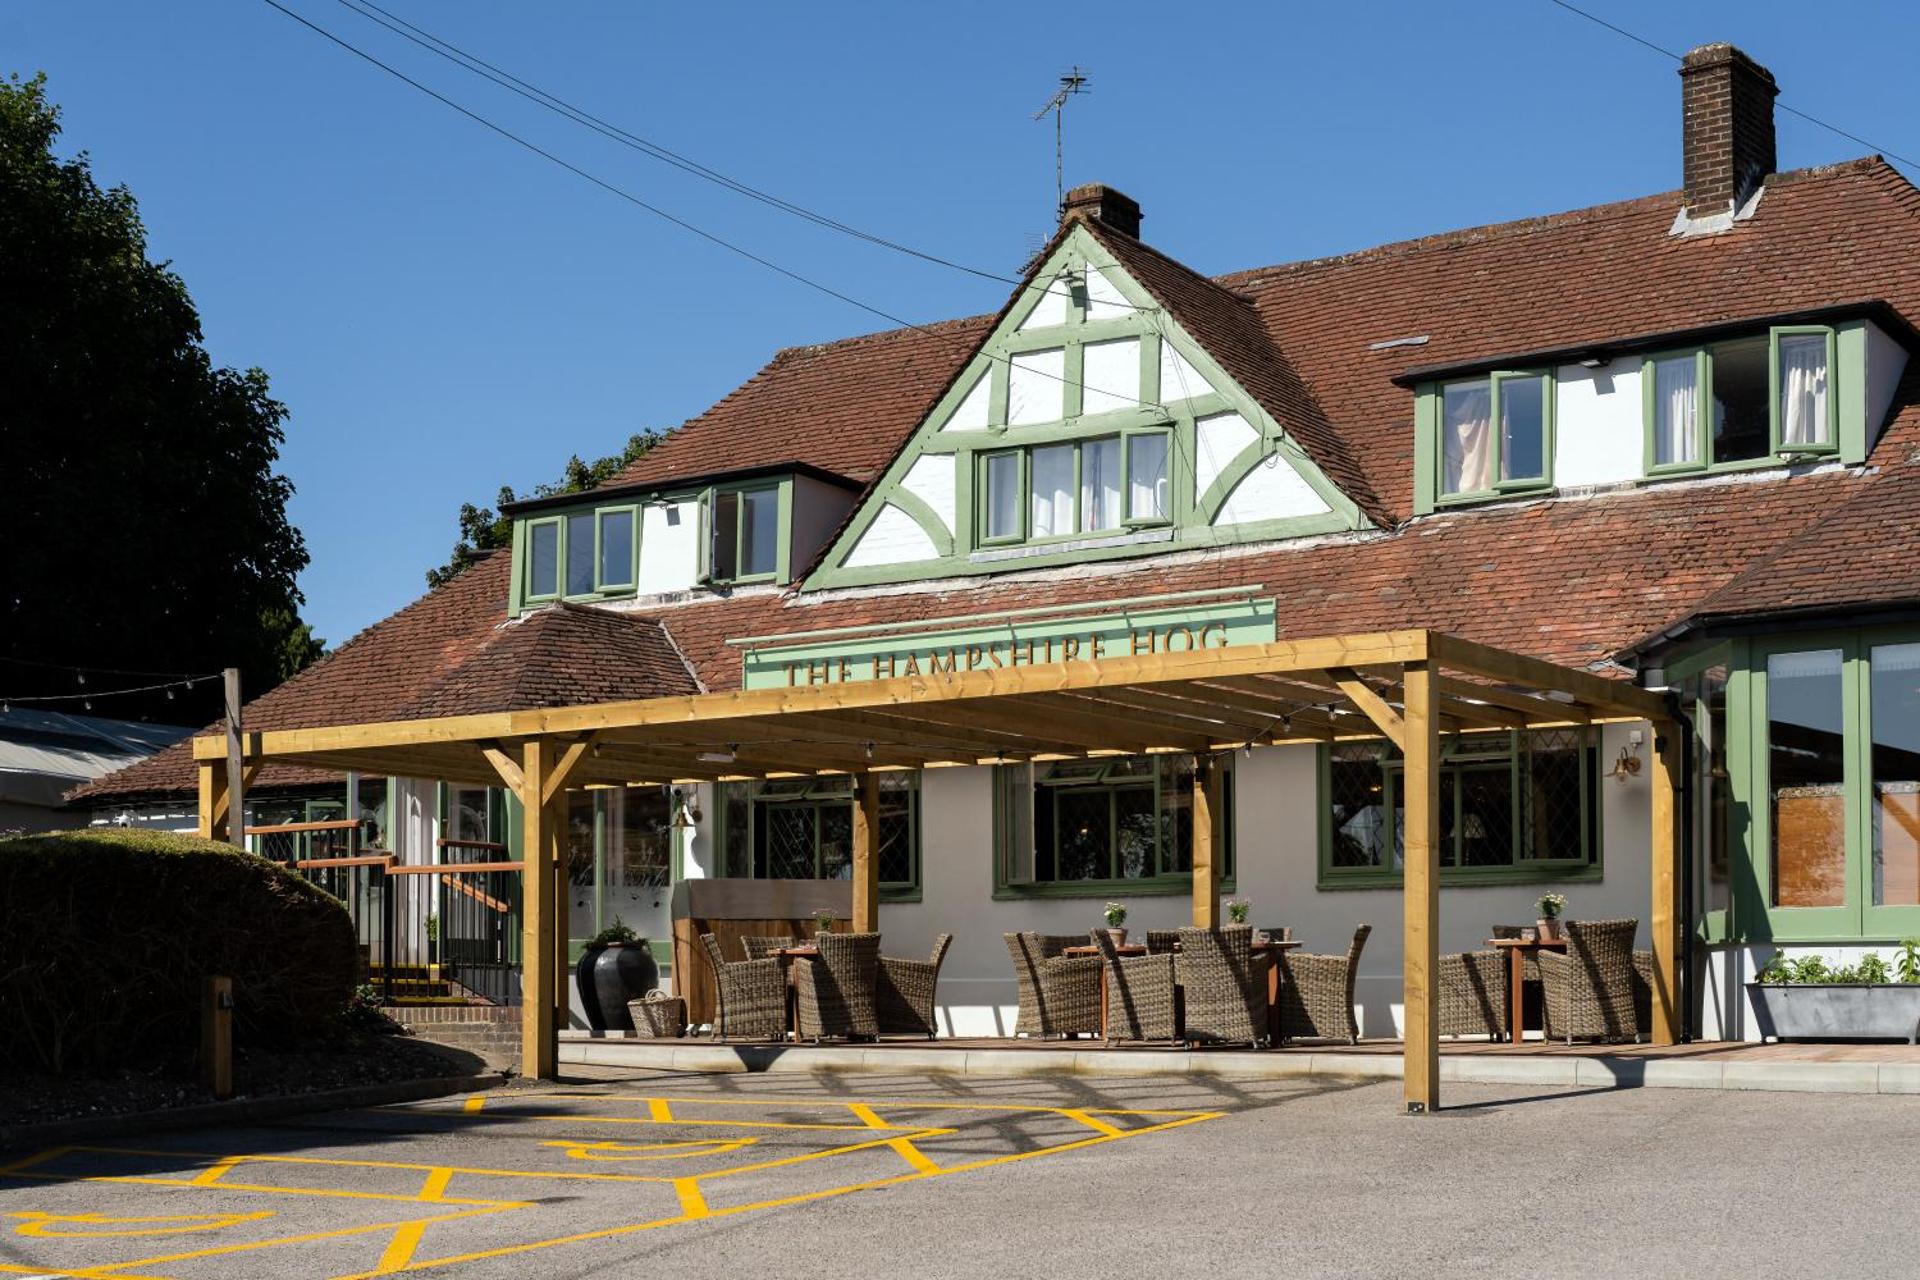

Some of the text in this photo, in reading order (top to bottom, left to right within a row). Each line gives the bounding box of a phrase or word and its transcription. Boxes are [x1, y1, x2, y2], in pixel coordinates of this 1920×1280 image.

[781, 624, 1227, 687] THE HAMPSHIRE HOG
